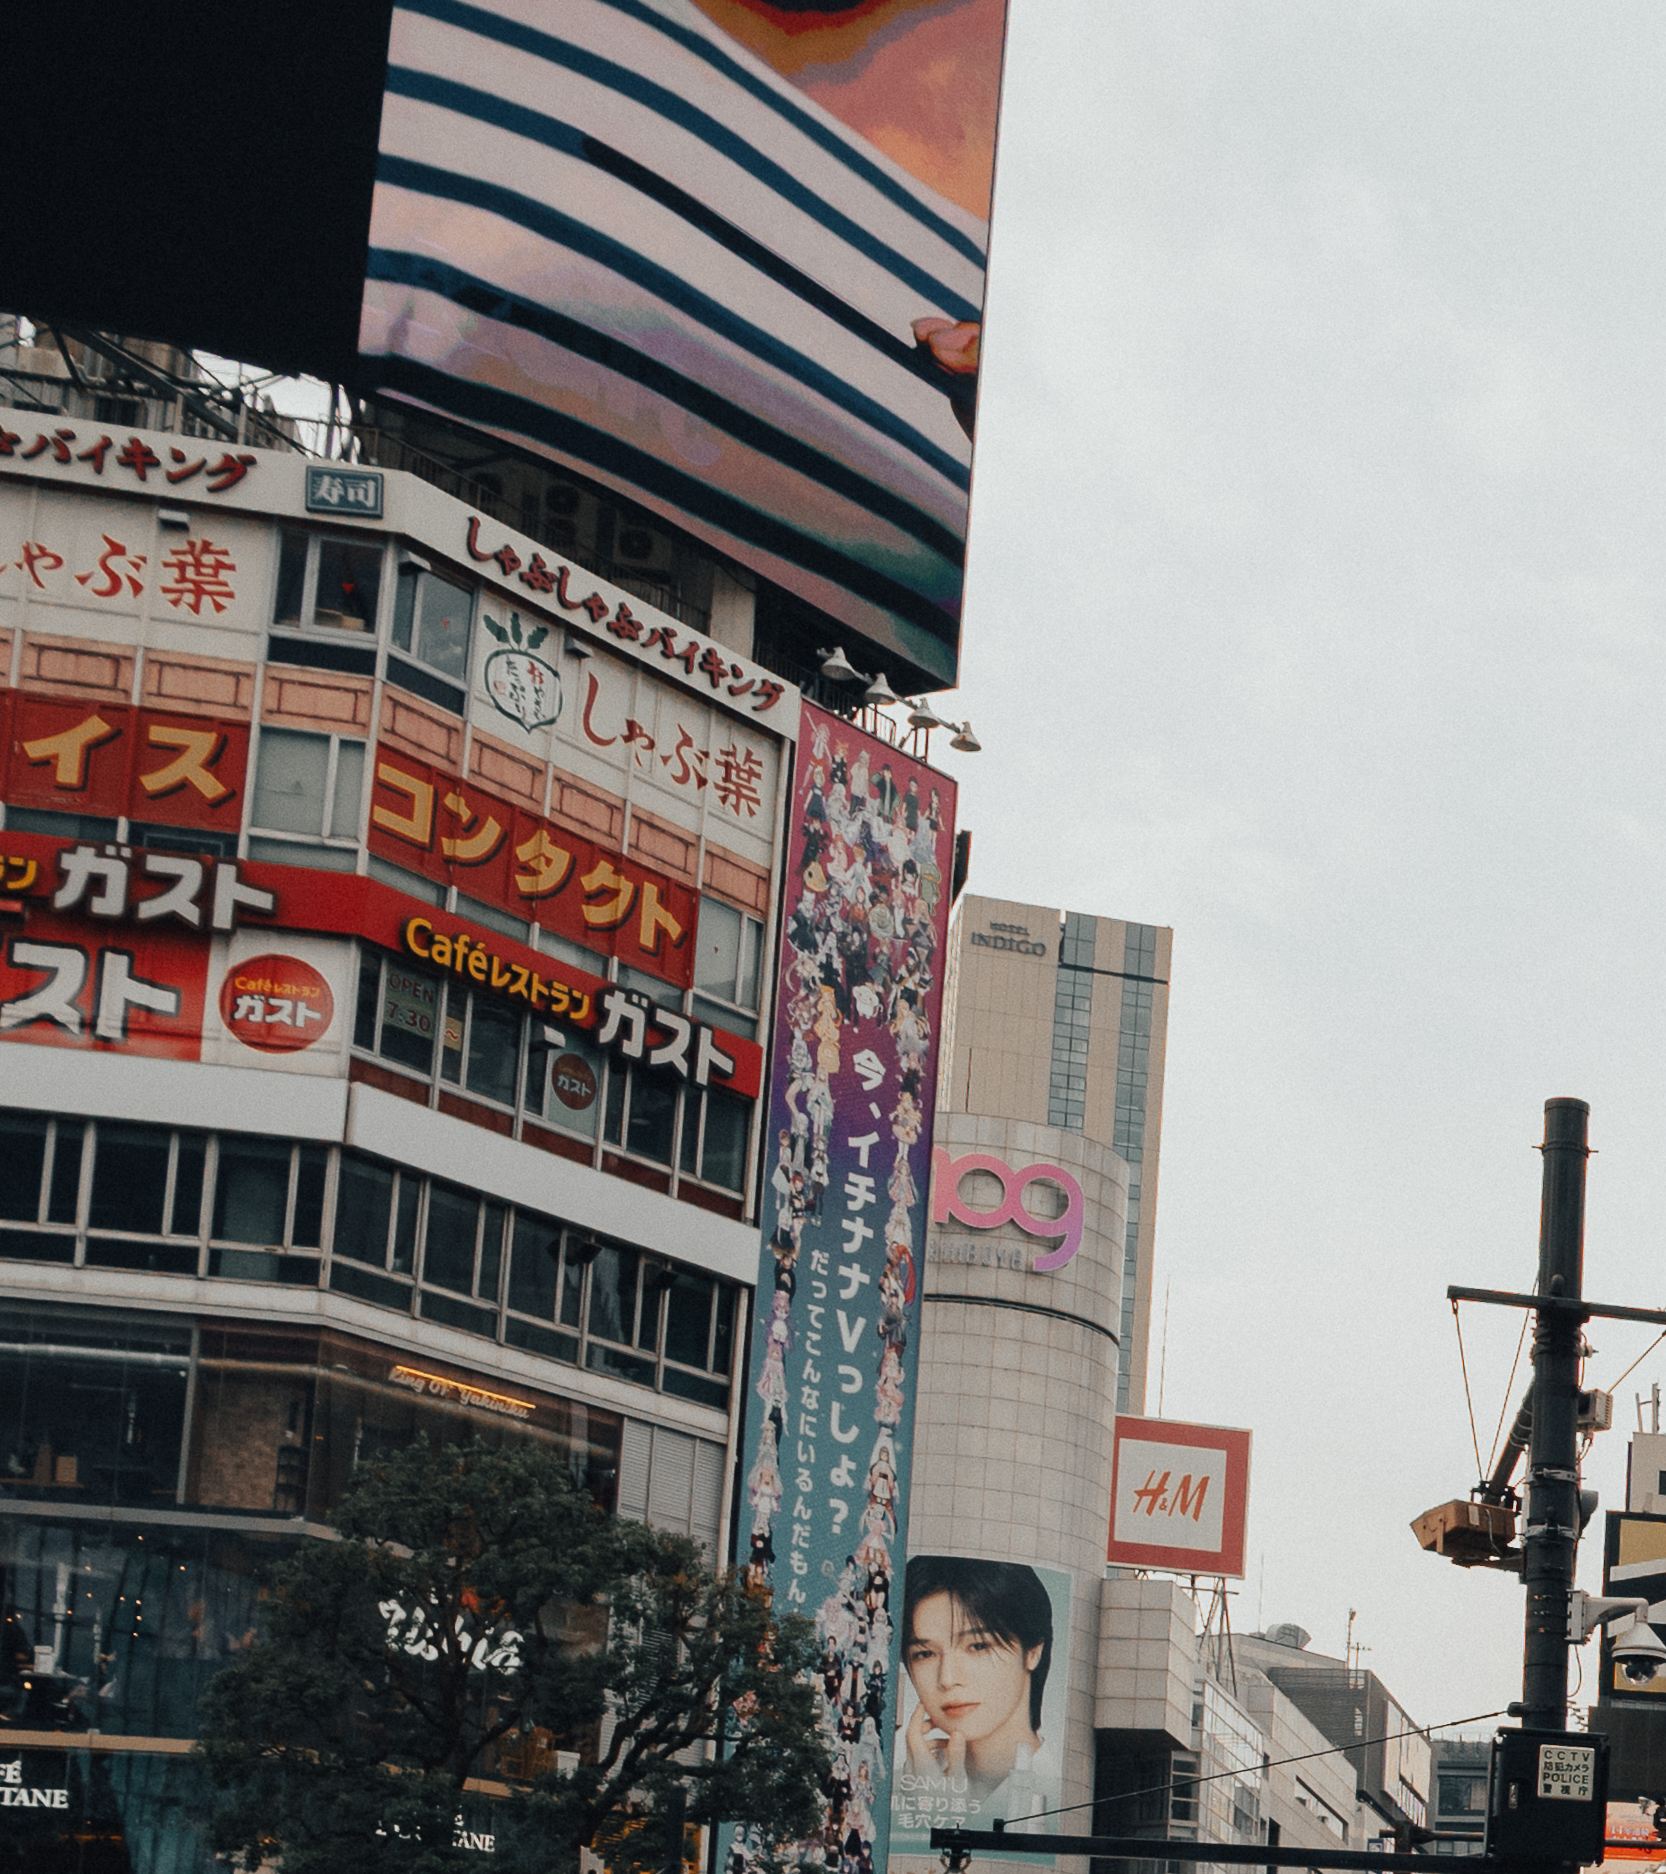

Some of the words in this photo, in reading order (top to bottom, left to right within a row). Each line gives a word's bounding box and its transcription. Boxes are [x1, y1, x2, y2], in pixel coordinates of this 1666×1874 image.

[313, 474, 376, 508] 寿司
[0, 534, 236, 616] ゃぶ葉
[467, 515, 785, 711] しゃぶしゃぶバイキング
[583, 672, 763, 818] しゃぶ葉
[373, 762, 682, 949] コンタクト
[55, 844, 274, 929] ガスト
[971, 931, 1047, 957] INDIGO
[1, 942, 178, 1039] スト
[389, 972, 434, 1003] OPEN
[234, 996, 321, 1028] ガスト
[599, 989, 734, 1086] ガスト
[557, 1074, 591, 1097] ガスト
[932, 1146, 1084, 1272] 109
[1133, 1469, 1208, 1524] H&M
[1544, 1750, 1590, 1761] CCTV
[1544, 1761, 1589, 1773] 防犯カメラ
[1543, 1772, 1589, 1784] POLICE
[898, 1813, 966, 1830] 毛穴ケア
